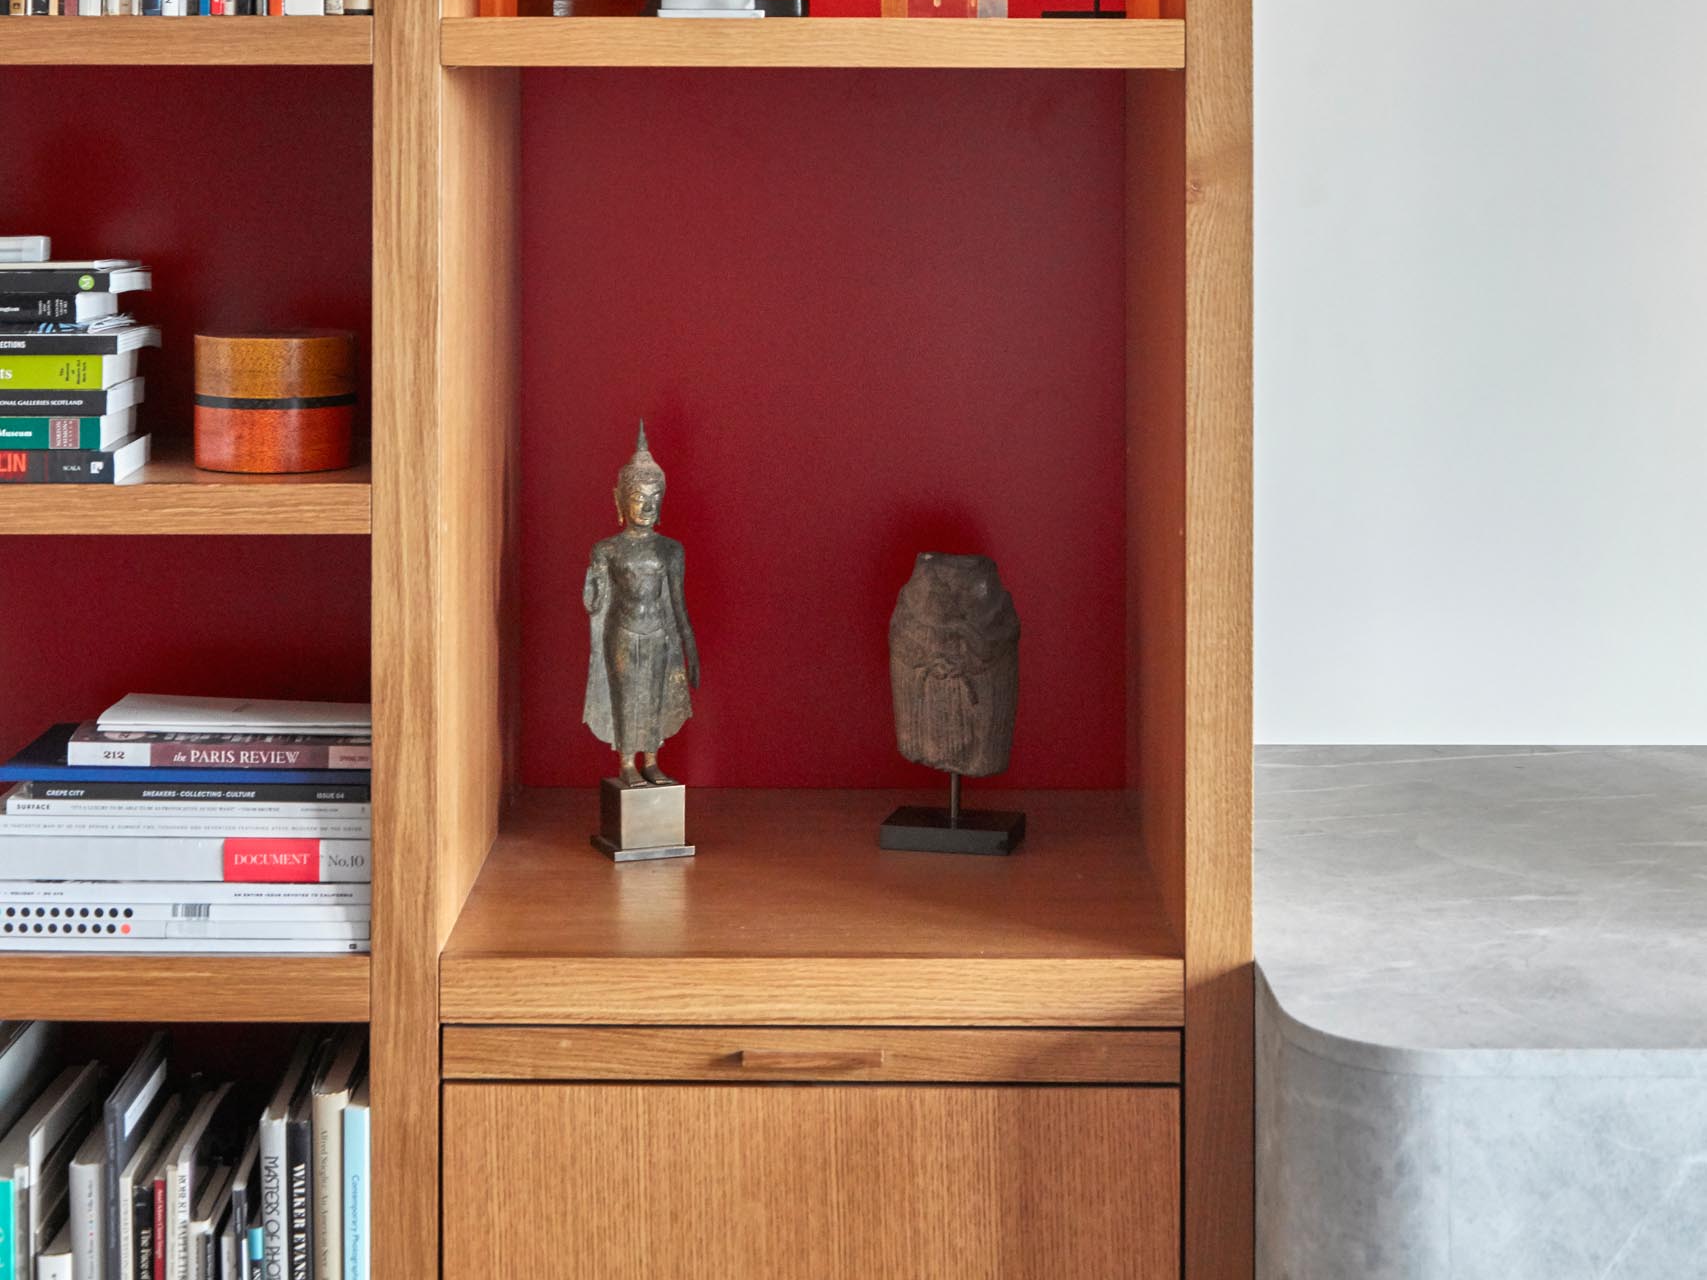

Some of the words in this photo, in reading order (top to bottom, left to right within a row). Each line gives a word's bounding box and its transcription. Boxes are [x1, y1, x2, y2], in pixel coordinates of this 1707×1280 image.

[103, 750, 125, 760] 212
[173, 751, 187, 762] the
[190, 750, 235, 763] PARIS
[239, 751, 300, 764] REVIEW
[142, 790, 177, 798] SNEAKERS
[233, 853, 310, 866] DOCUMENT
[327, 855, 365, 868] No.10
[264, 1155, 280, 1216] MASTERS
[293, 1163, 306, 1228] WALKER
[350, 1175, 360, 1232] Contemporary
[140, 1229, 151, 1248] The
[264, 1219, 281, 1241] OF
[140, 1249, 151, 1269] Face
